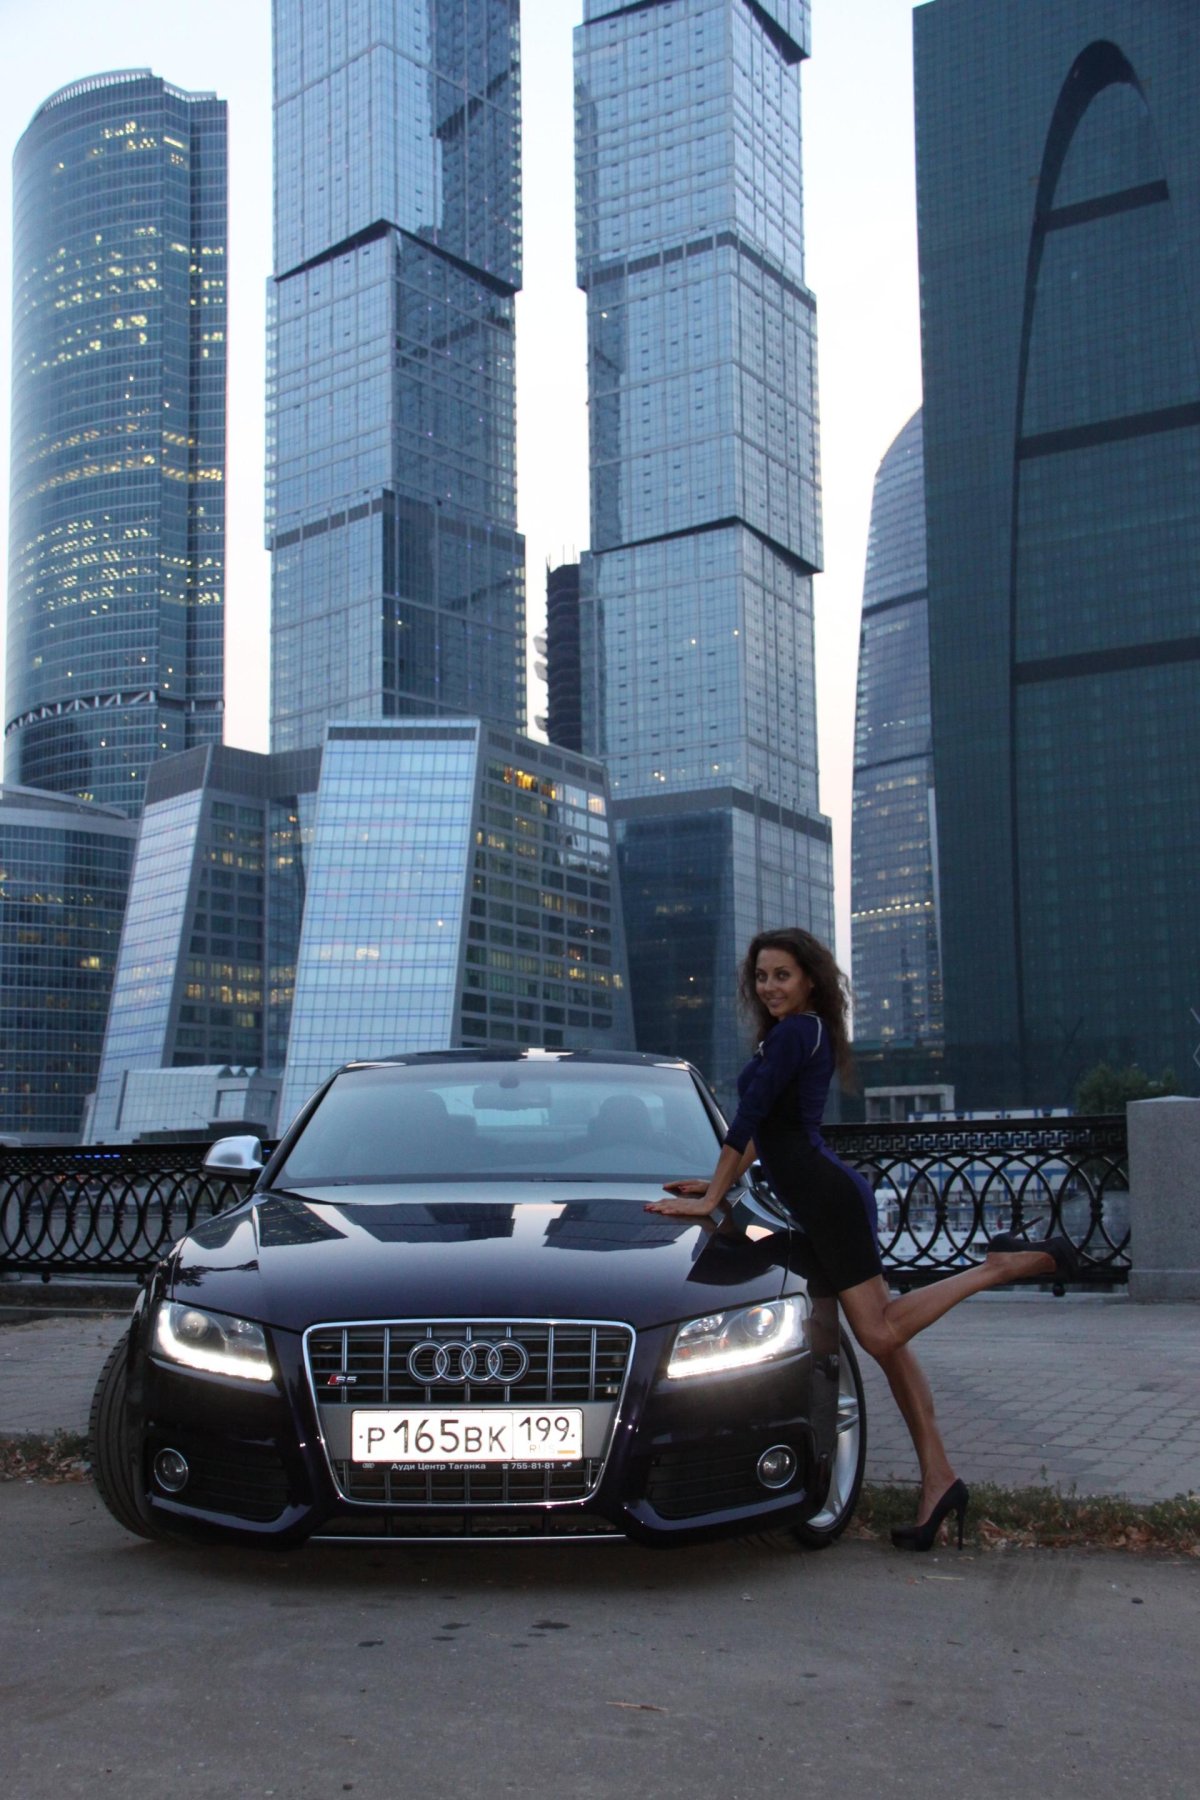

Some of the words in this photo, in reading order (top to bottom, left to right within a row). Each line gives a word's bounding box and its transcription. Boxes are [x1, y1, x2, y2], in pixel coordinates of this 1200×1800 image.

[519, 1416, 570, 1442] 199
[391, 1462, 415, 1471] Ауди
[418, 1462, 446, 1471] Центр
[448, 1462, 486, 1470] Таганка
[511, 1462, 555, 1470] 755-81-81
